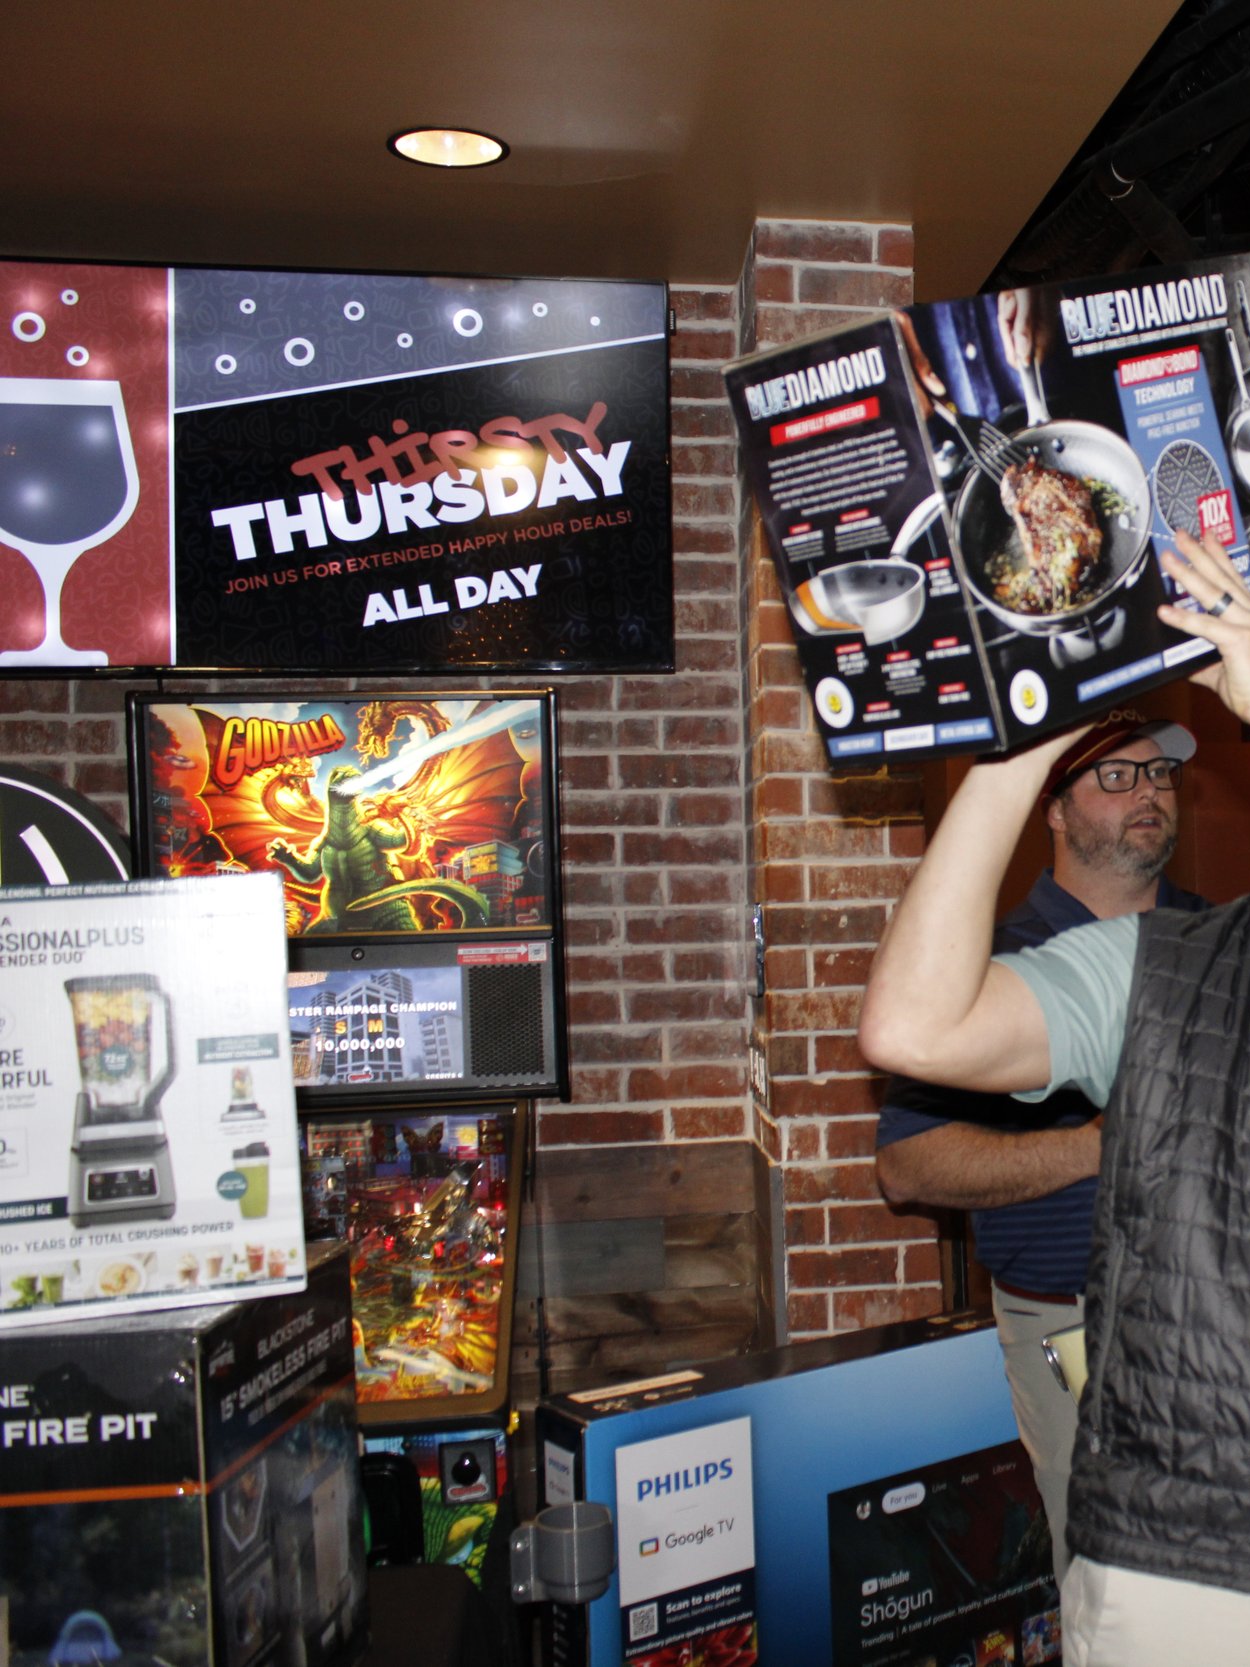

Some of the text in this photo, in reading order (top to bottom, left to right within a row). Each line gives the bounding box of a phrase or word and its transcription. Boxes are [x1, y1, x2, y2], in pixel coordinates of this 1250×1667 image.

[1134, 377, 1195, 406] TECHNOLOGY
[290, 401, 608, 501] THIRSTY
[211, 440, 632, 561] THURSDAY
[1199, 493, 1230, 529] 10X
[225, 510, 632, 595] JOIN US FOR EXTENDED HAPPY HOUR DEALS!
[362, 563, 543, 628] ALL DAY
[214, 713, 345, 789] GODZILLA
[44, 885, 82, 897] PERFECT
[84, 884, 126, 895] NUTRIENT
[288, 1001, 457, 1017] STER RAMPAGE CHAMPION
[334, 1019, 384, 1034] S M
[315, 1037, 406, 1053] 10,000,000
[425, 1072, 456, 1080] CREDITS
[36, 1202, 53, 1215] ICE
[25, 1239, 66, 1253] YEARS
[70, 1237, 84, 1249] OF
[88, 1231, 124, 1246] TOTAL
[127, 1226, 189, 1242] CRUSHING
[191, 1221, 235, 1235] POWER
[256, 1307, 315, 1360] BLACKSTONE
[238, 1345, 307, 1410] SMOKELESS
[306, 1327, 331, 1362] FIRE
[331, 1316, 347, 1344] PIT
[3, 1411, 158, 1448] FIRE PIT
[637, 1458, 734, 1502] PHILIPS
[961, 1472, 979, 1486] Apps
[992, 1461, 1017, 1475] Library
[890, 1491, 918, 1506] For you
[931, 1482, 947, 1494] Live
[665, 1518, 735, 1549] Google TV
[878, 1570, 911, 1590] YouTube
[665, 1583, 742, 1615] Scan to explore
[860, 1588, 934, 1628] Shōgun
[861, 1630, 894, 1650] Trending
[901, 1626, 908, 1635] A
[908, 1620, 923, 1632] tale
[923, 1616, 932, 1626] of
[983, 1594, 997, 1605] and
[997, 1584, 1024, 1601] cultural
[1023, 1576, 1049, 1591] conflict
